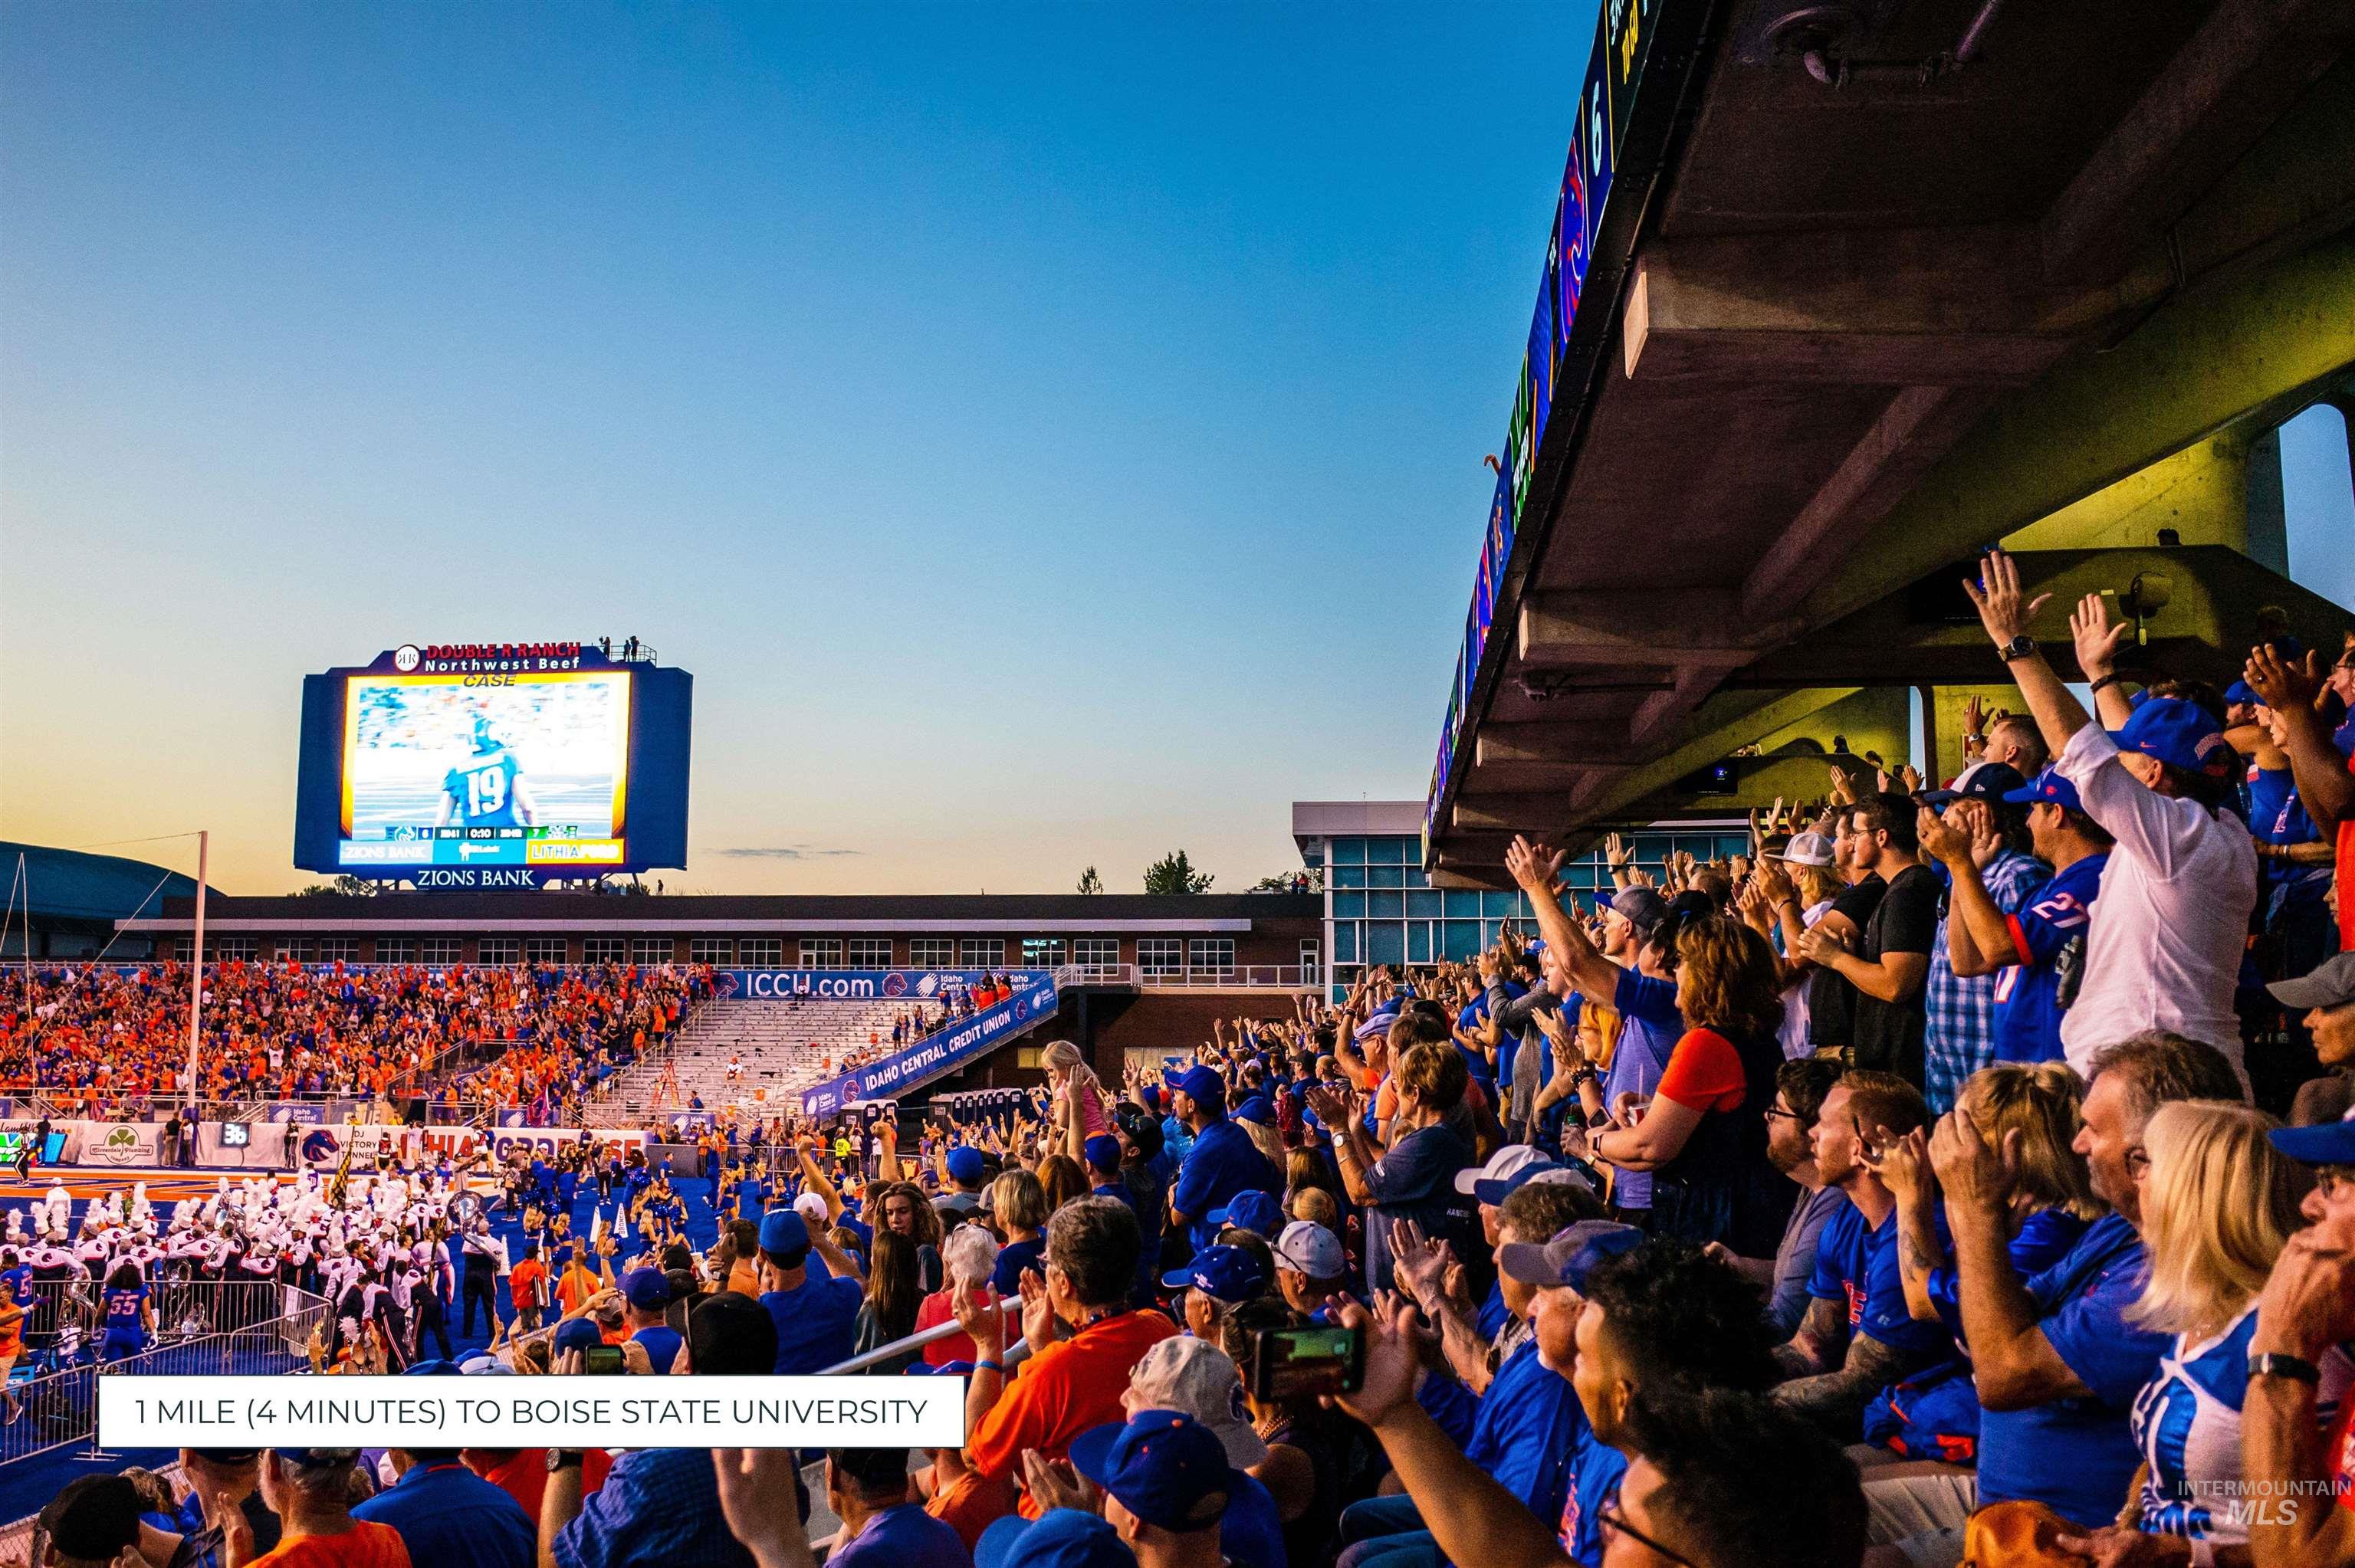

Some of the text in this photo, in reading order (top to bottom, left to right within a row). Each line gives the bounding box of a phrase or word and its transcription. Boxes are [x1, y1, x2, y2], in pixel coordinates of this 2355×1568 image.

[426, 641, 581, 660] DOUBLE R RANCH
[425, 657, 580, 672] Northwest Beef
[463, 674, 517, 687] CASE
[467, 766, 505, 818] 19
[345, 846, 425, 858] ZIONS BANK
[533, 845, 579, 858] LITHIA
[418, 870, 535, 886] ZIONS BANK
[747, 973, 874, 996] ICCU.com
[865, 1010, 1010, 1091] IDAHO CENTRAL CREDIT UNION
[110, 1294, 140, 1315] 55
